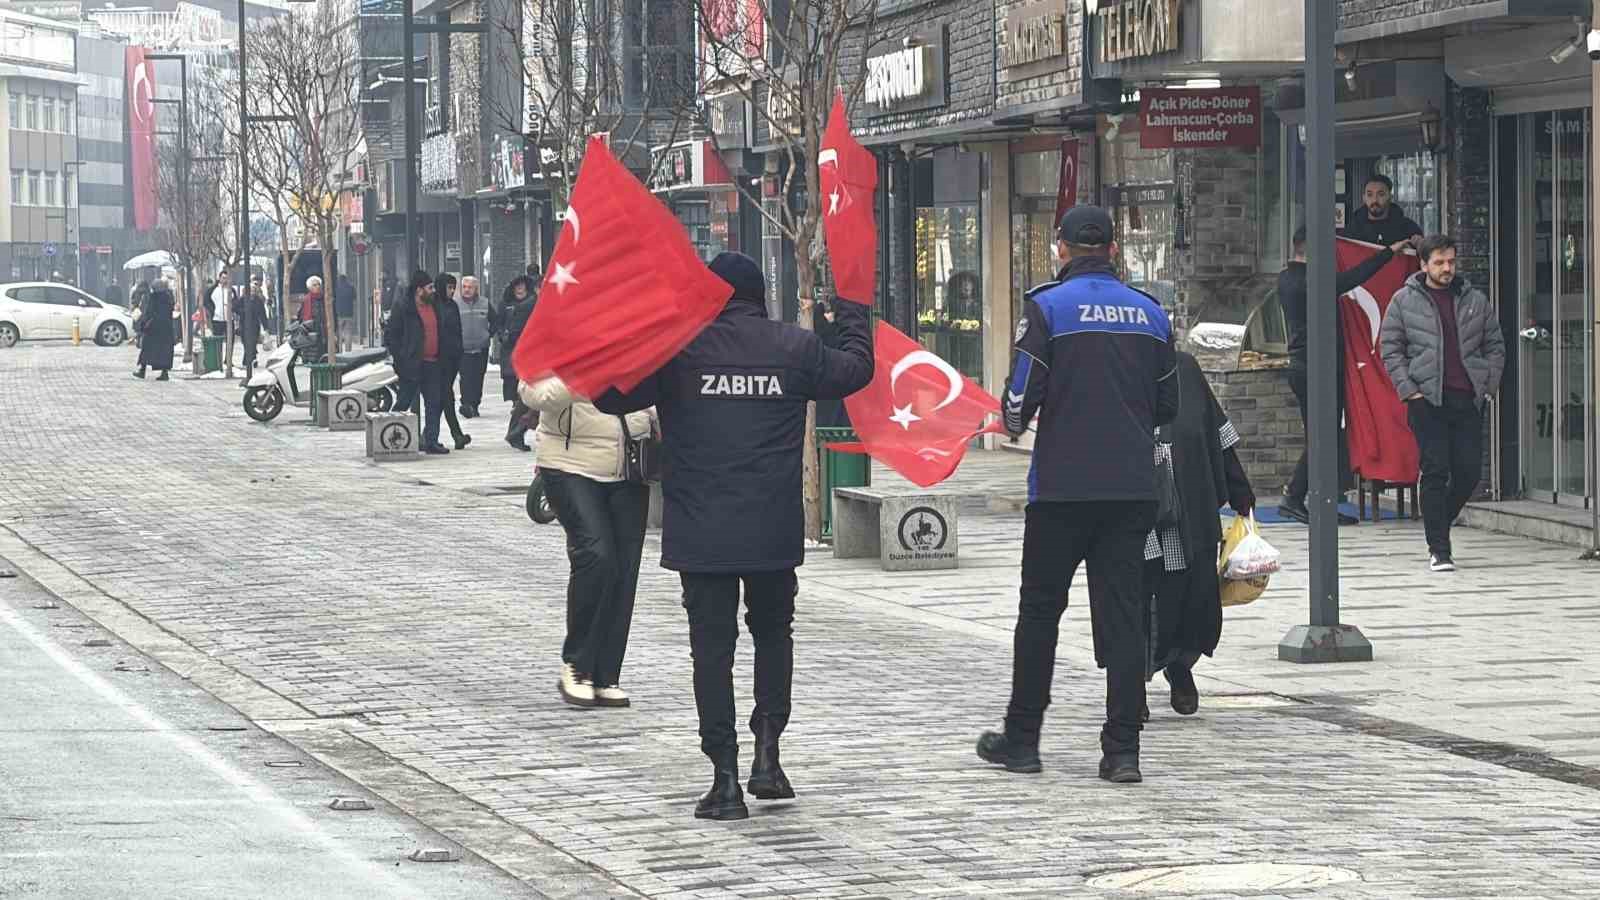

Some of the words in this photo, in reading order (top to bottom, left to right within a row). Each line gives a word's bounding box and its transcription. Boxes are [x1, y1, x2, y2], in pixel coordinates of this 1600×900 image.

[1149, 97, 1177, 111] Açık
[1180, 96, 1251, 110] Pide-Döner
[1146, 112, 1254, 128] Lahmacun-Çorba
[1173, 127, 1228, 142] İskender
[1078, 304, 1149, 325] ZABITA
[700, 374, 783, 395] ZABITA
